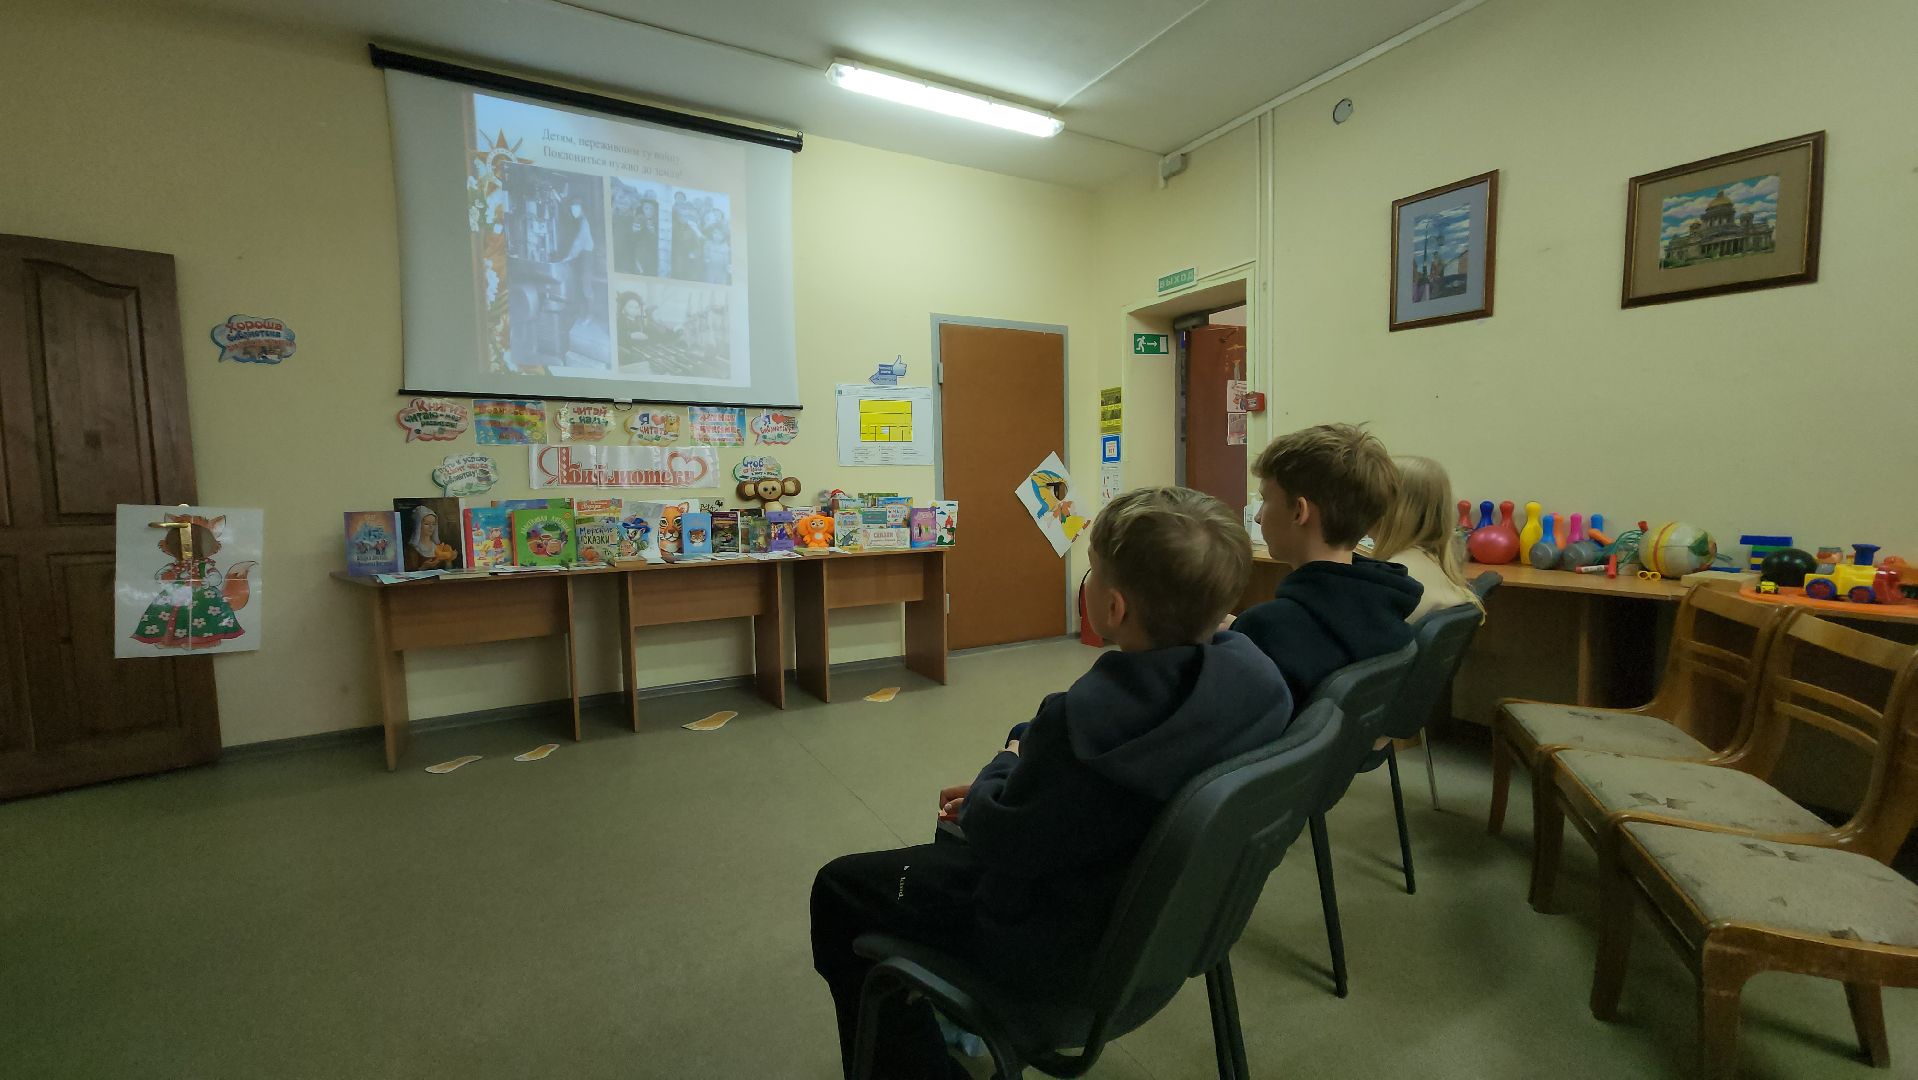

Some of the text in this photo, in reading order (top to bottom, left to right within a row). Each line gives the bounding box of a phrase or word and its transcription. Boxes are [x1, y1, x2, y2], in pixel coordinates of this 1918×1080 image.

[543, 145, 607, 167] Поклониться
[609, 160, 640, 173] нужно
[1159, 271, 1194, 289] ВЫХОД
[639, 413, 650, 426] Я
